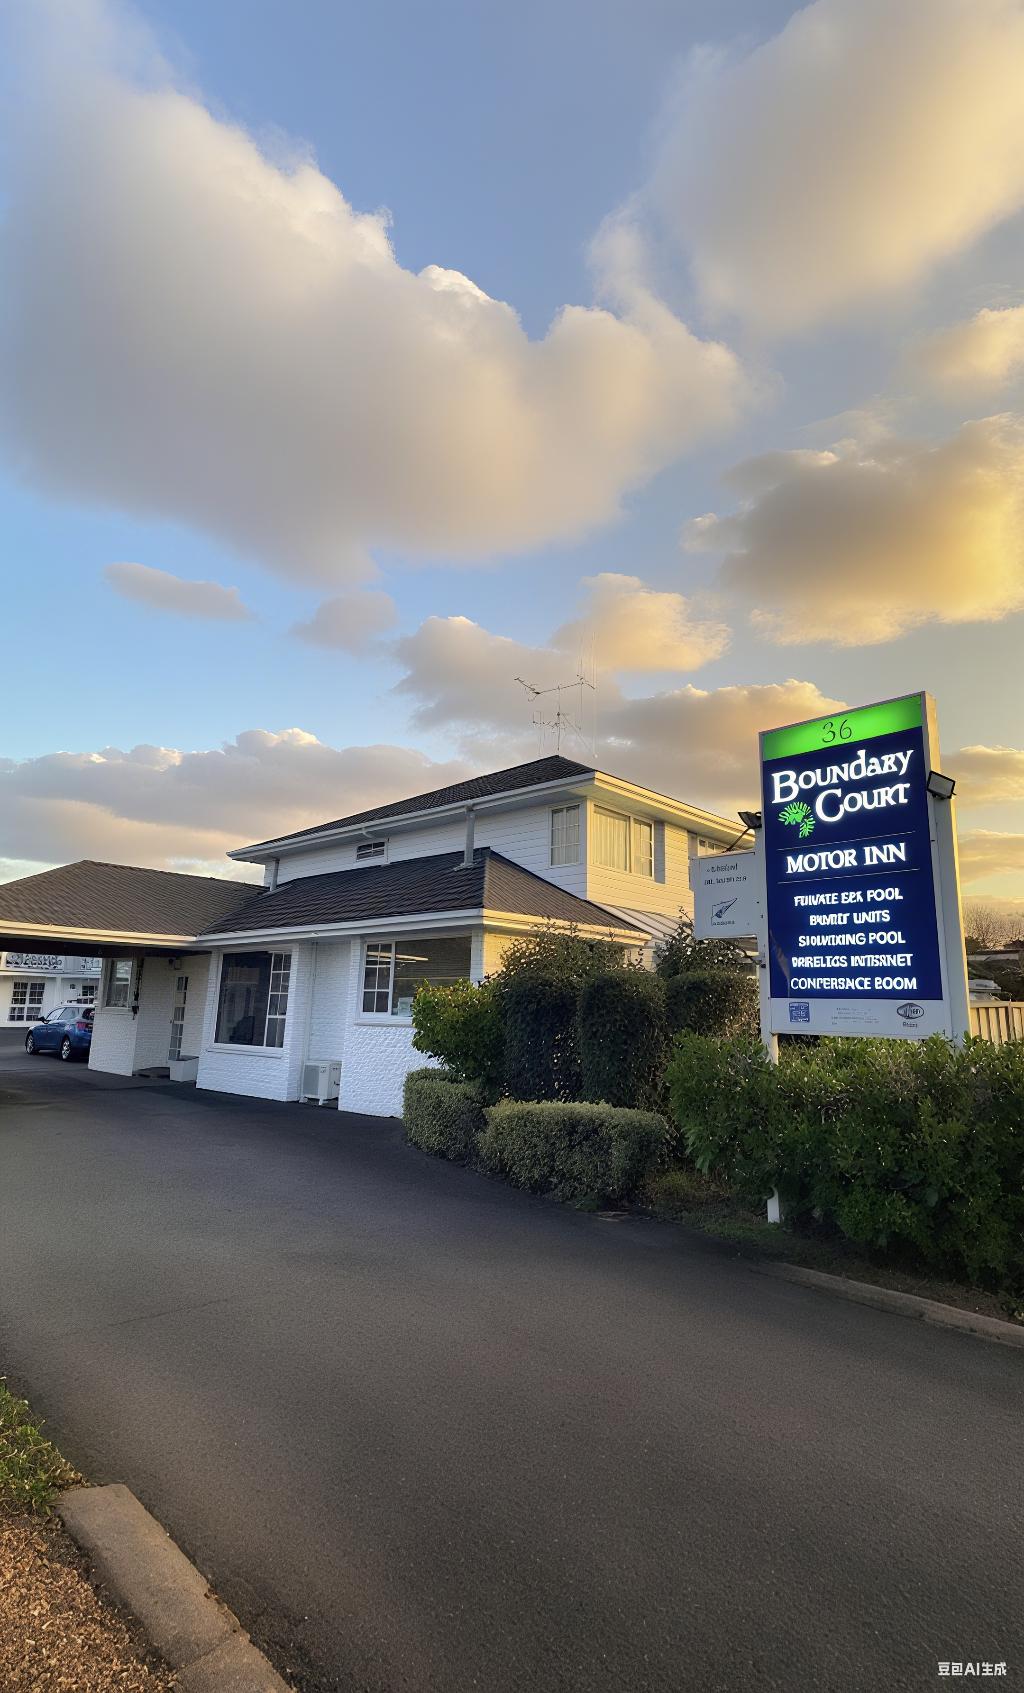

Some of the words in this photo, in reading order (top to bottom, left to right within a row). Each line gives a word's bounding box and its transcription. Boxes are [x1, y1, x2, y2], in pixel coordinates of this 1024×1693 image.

[822, 719, 852, 743] 36
[785, 848, 858, 874] MOTOR
[863, 842, 906, 866] INN
[866, 887, 904, 902] POOL
[853, 909, 891, 924] UNITS
[868, 931, 906, 945] POOL
